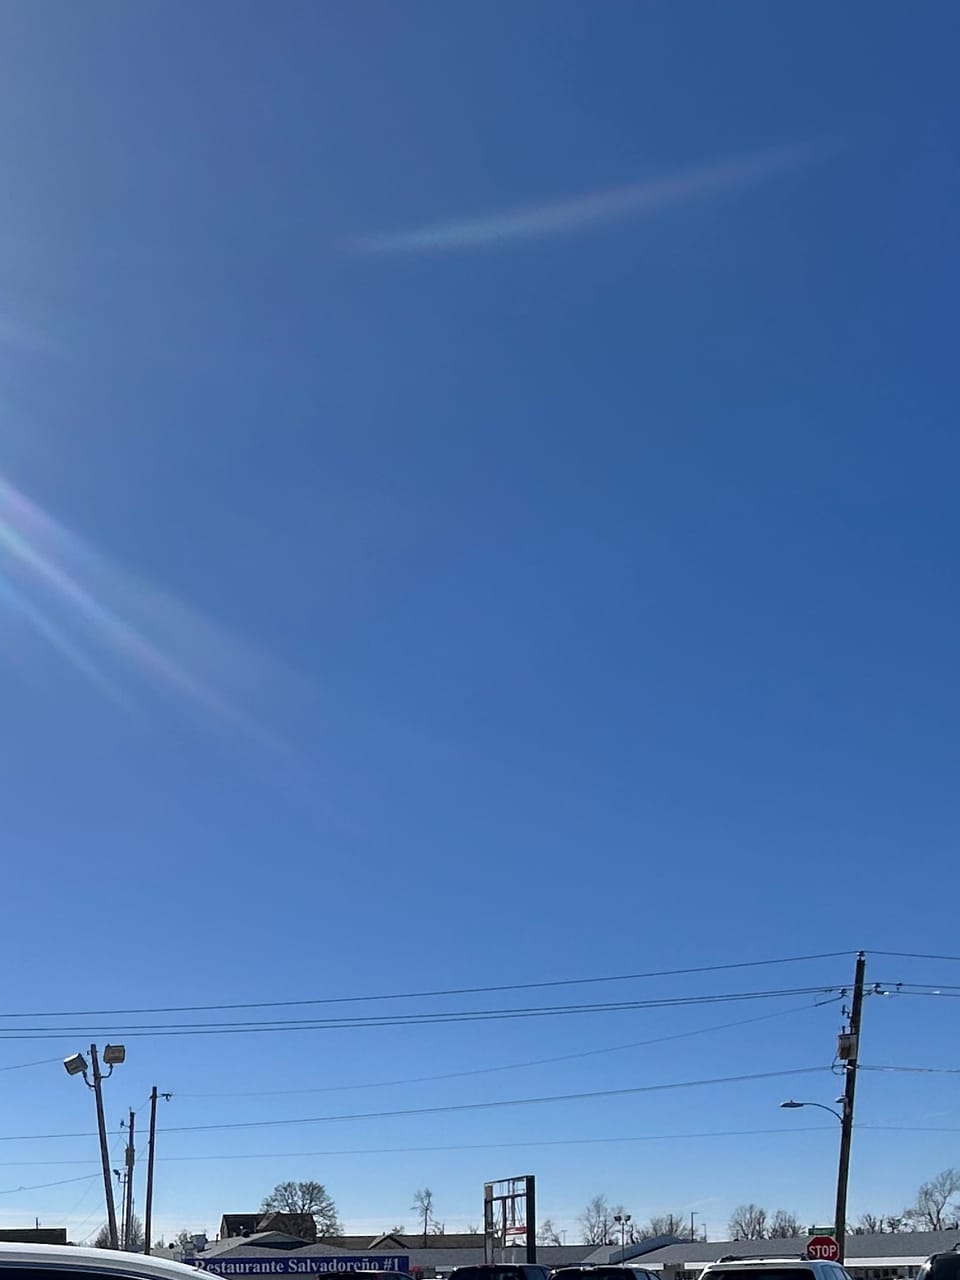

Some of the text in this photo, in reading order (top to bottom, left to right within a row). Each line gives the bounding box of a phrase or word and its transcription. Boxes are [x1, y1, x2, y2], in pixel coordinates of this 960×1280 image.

[809, 1245, 837, 1258] STOP
[194, 1257, 400, 1274] Restaurante Salvadoreño #1
